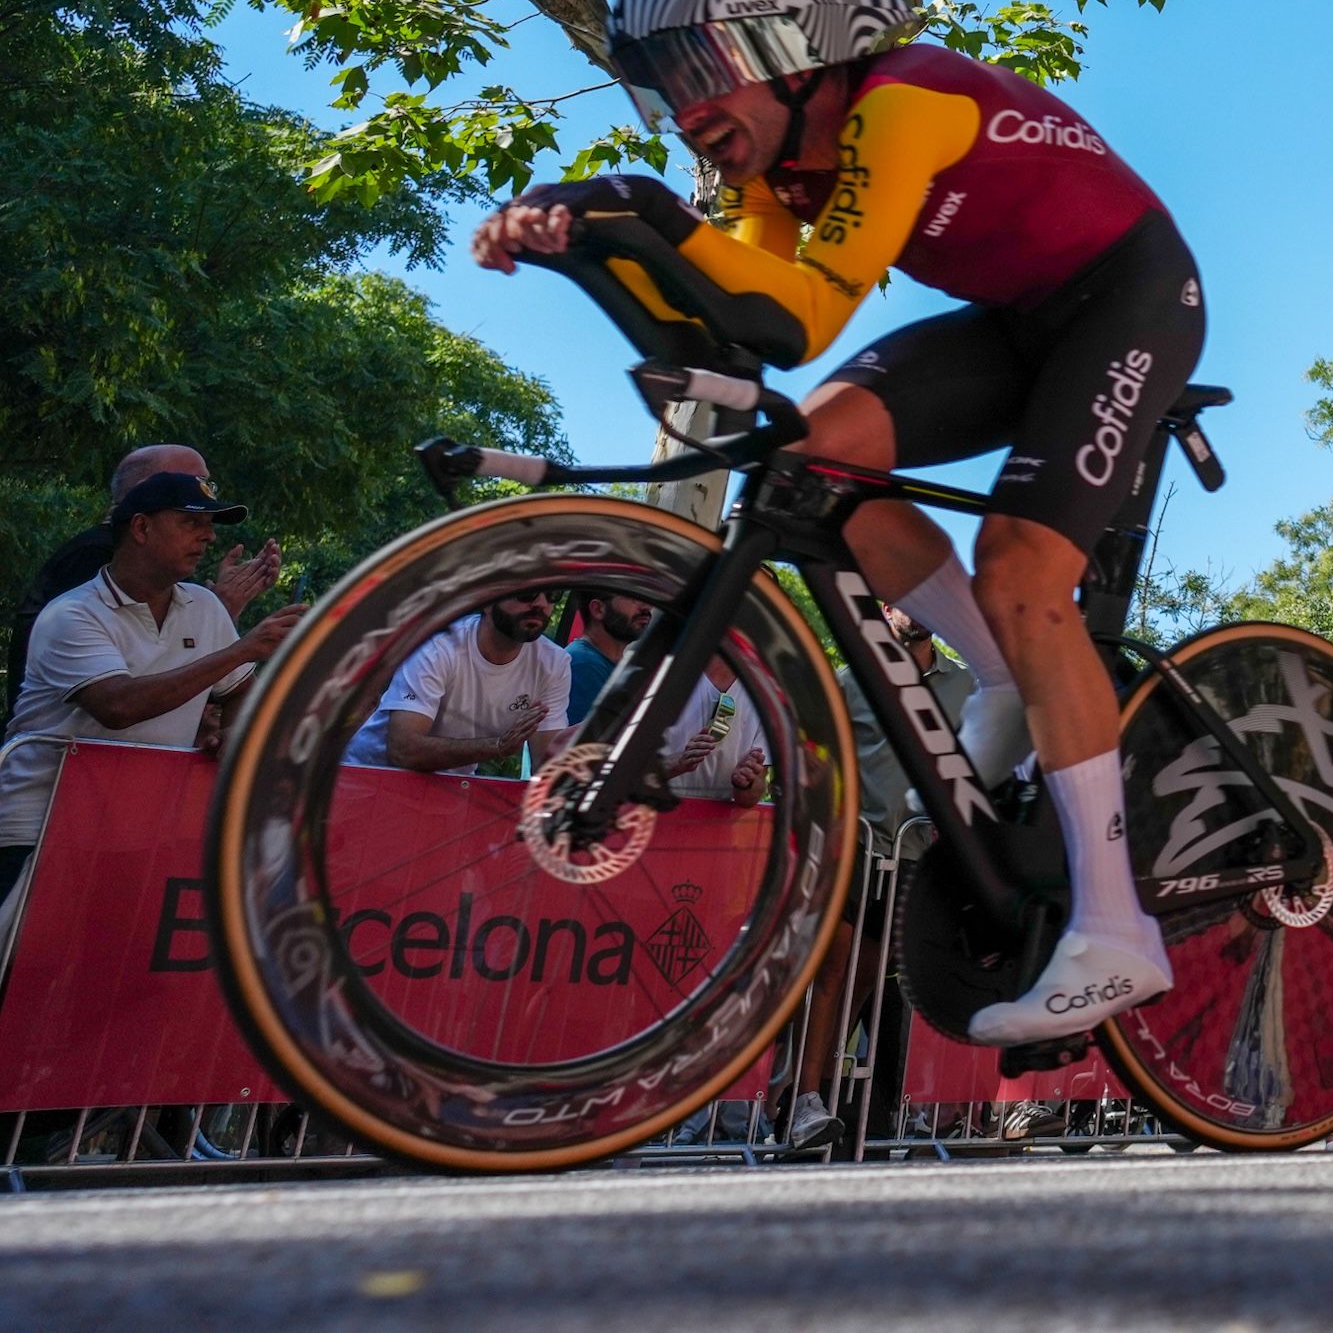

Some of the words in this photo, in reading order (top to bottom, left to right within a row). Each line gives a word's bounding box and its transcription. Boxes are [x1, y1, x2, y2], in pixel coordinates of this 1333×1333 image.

[726, 0, 782, 15] uvex
[986, 109, 1106, 155] Cofidis
[1075, 349, 1153, 487] Cofidis
[836, 571, 999, 826] LOOK
[1156, 873, 1221, 897] 796
[1247, 865, 1285, 883] RS
[148, 877, 633, 986] Bcelona
[1045, 975, 1134, 1014] Cofidis
[1168, 1061, 1257, 1116] BORA
